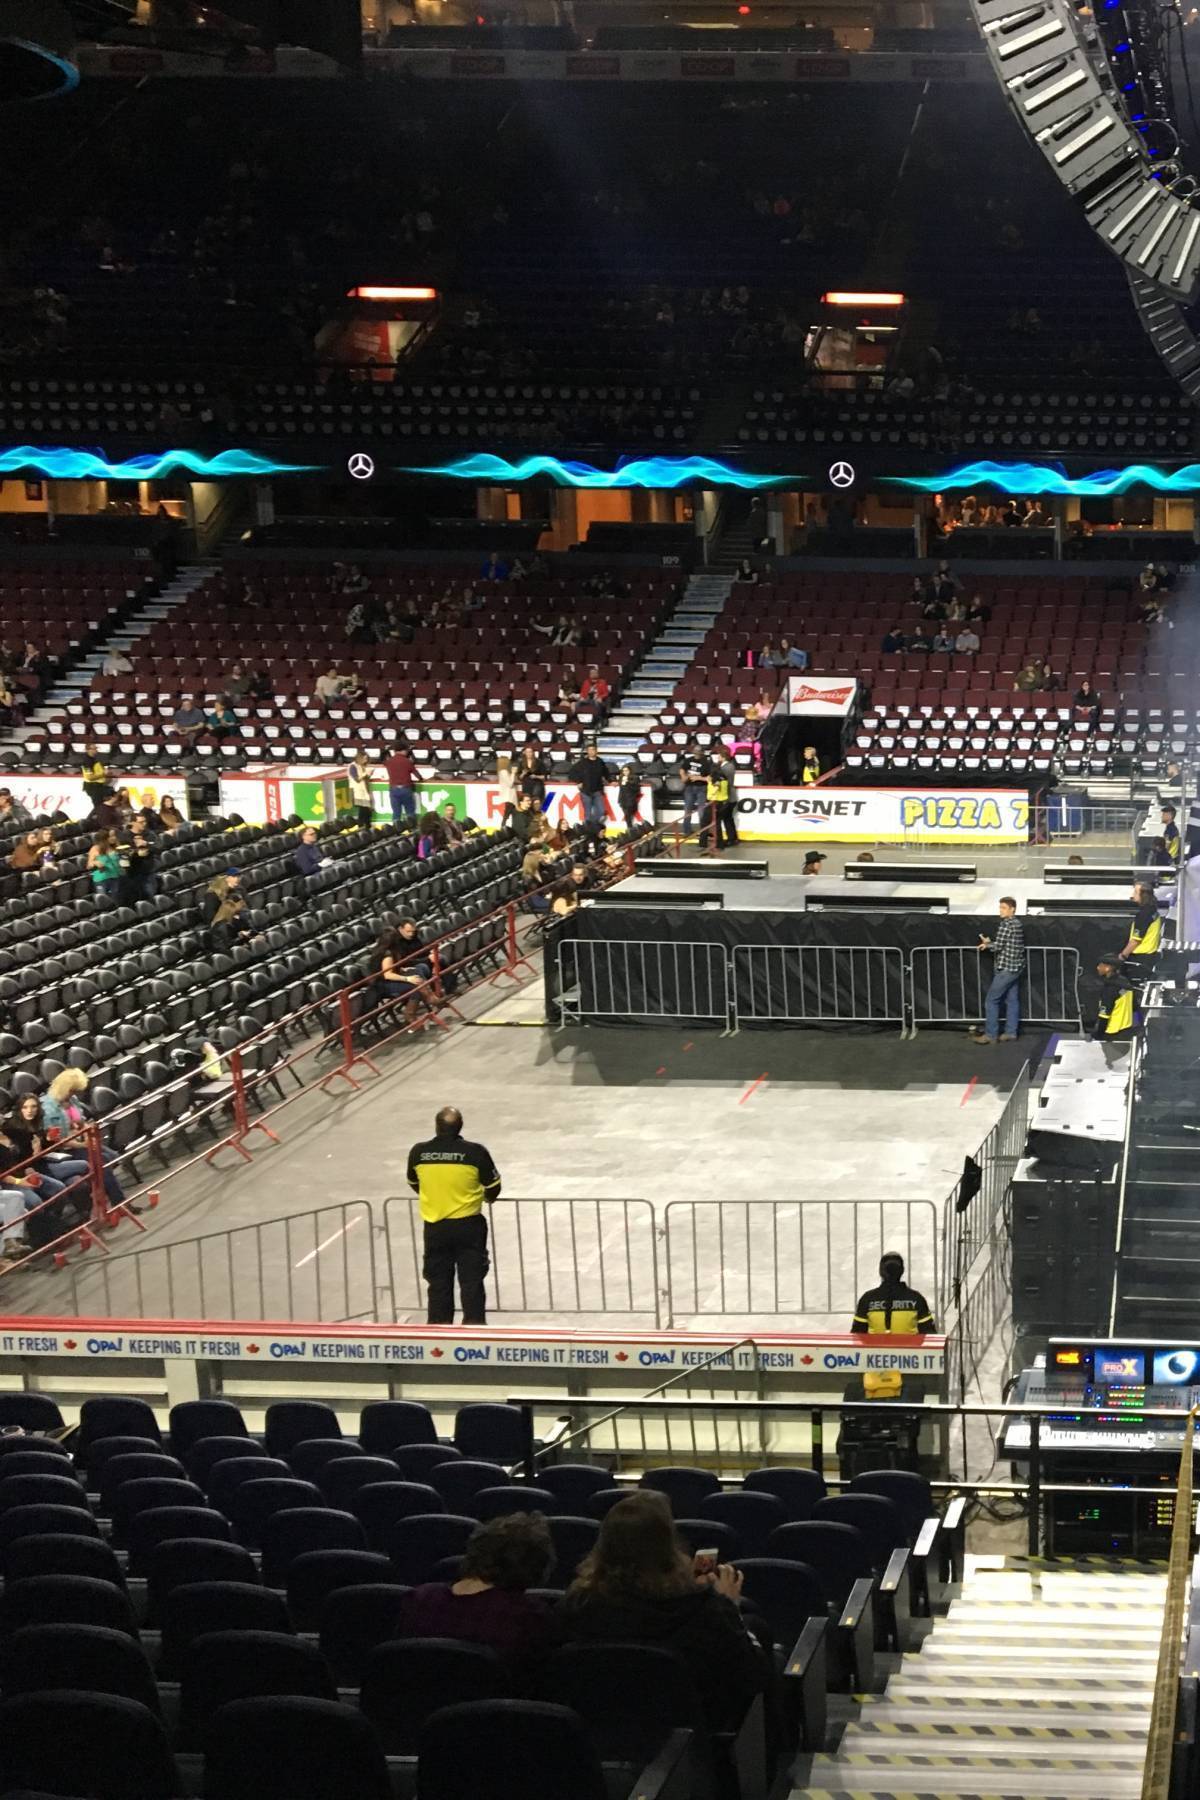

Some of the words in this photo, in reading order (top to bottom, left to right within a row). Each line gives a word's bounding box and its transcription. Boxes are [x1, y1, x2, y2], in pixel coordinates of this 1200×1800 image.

[662, 555, 680, 565] 109
[736, 797, 867, 816] ORTSNET
[900, 796, 1002, 829] PIZZA
[420, 1152, 466, 1161] SECURITY
[2, 1336, 14, 1350] IT
[18, 1337, 58, 1352] FRESH
[129, 1339, 182, 1354] KEEPING
[185, 1340, 197, 1354] IT
[200, 1340, 241, 1356] FRESH
[312, 1343, 365, 1358] KEEPING
[368, 1344, 380, 1359] IT
[384, 1344, 424, 1360] FRESH
[496, 1347, 549, 1363] KEEPING
[553, 1348, 565, 1363] IT
[568, 1349, 609, 1364] FRESH
[738, 1352, 750, 1366] IT
[866, 1354, 919, 1369] KEEPING
[923, 1355, 935, 1369] IT
